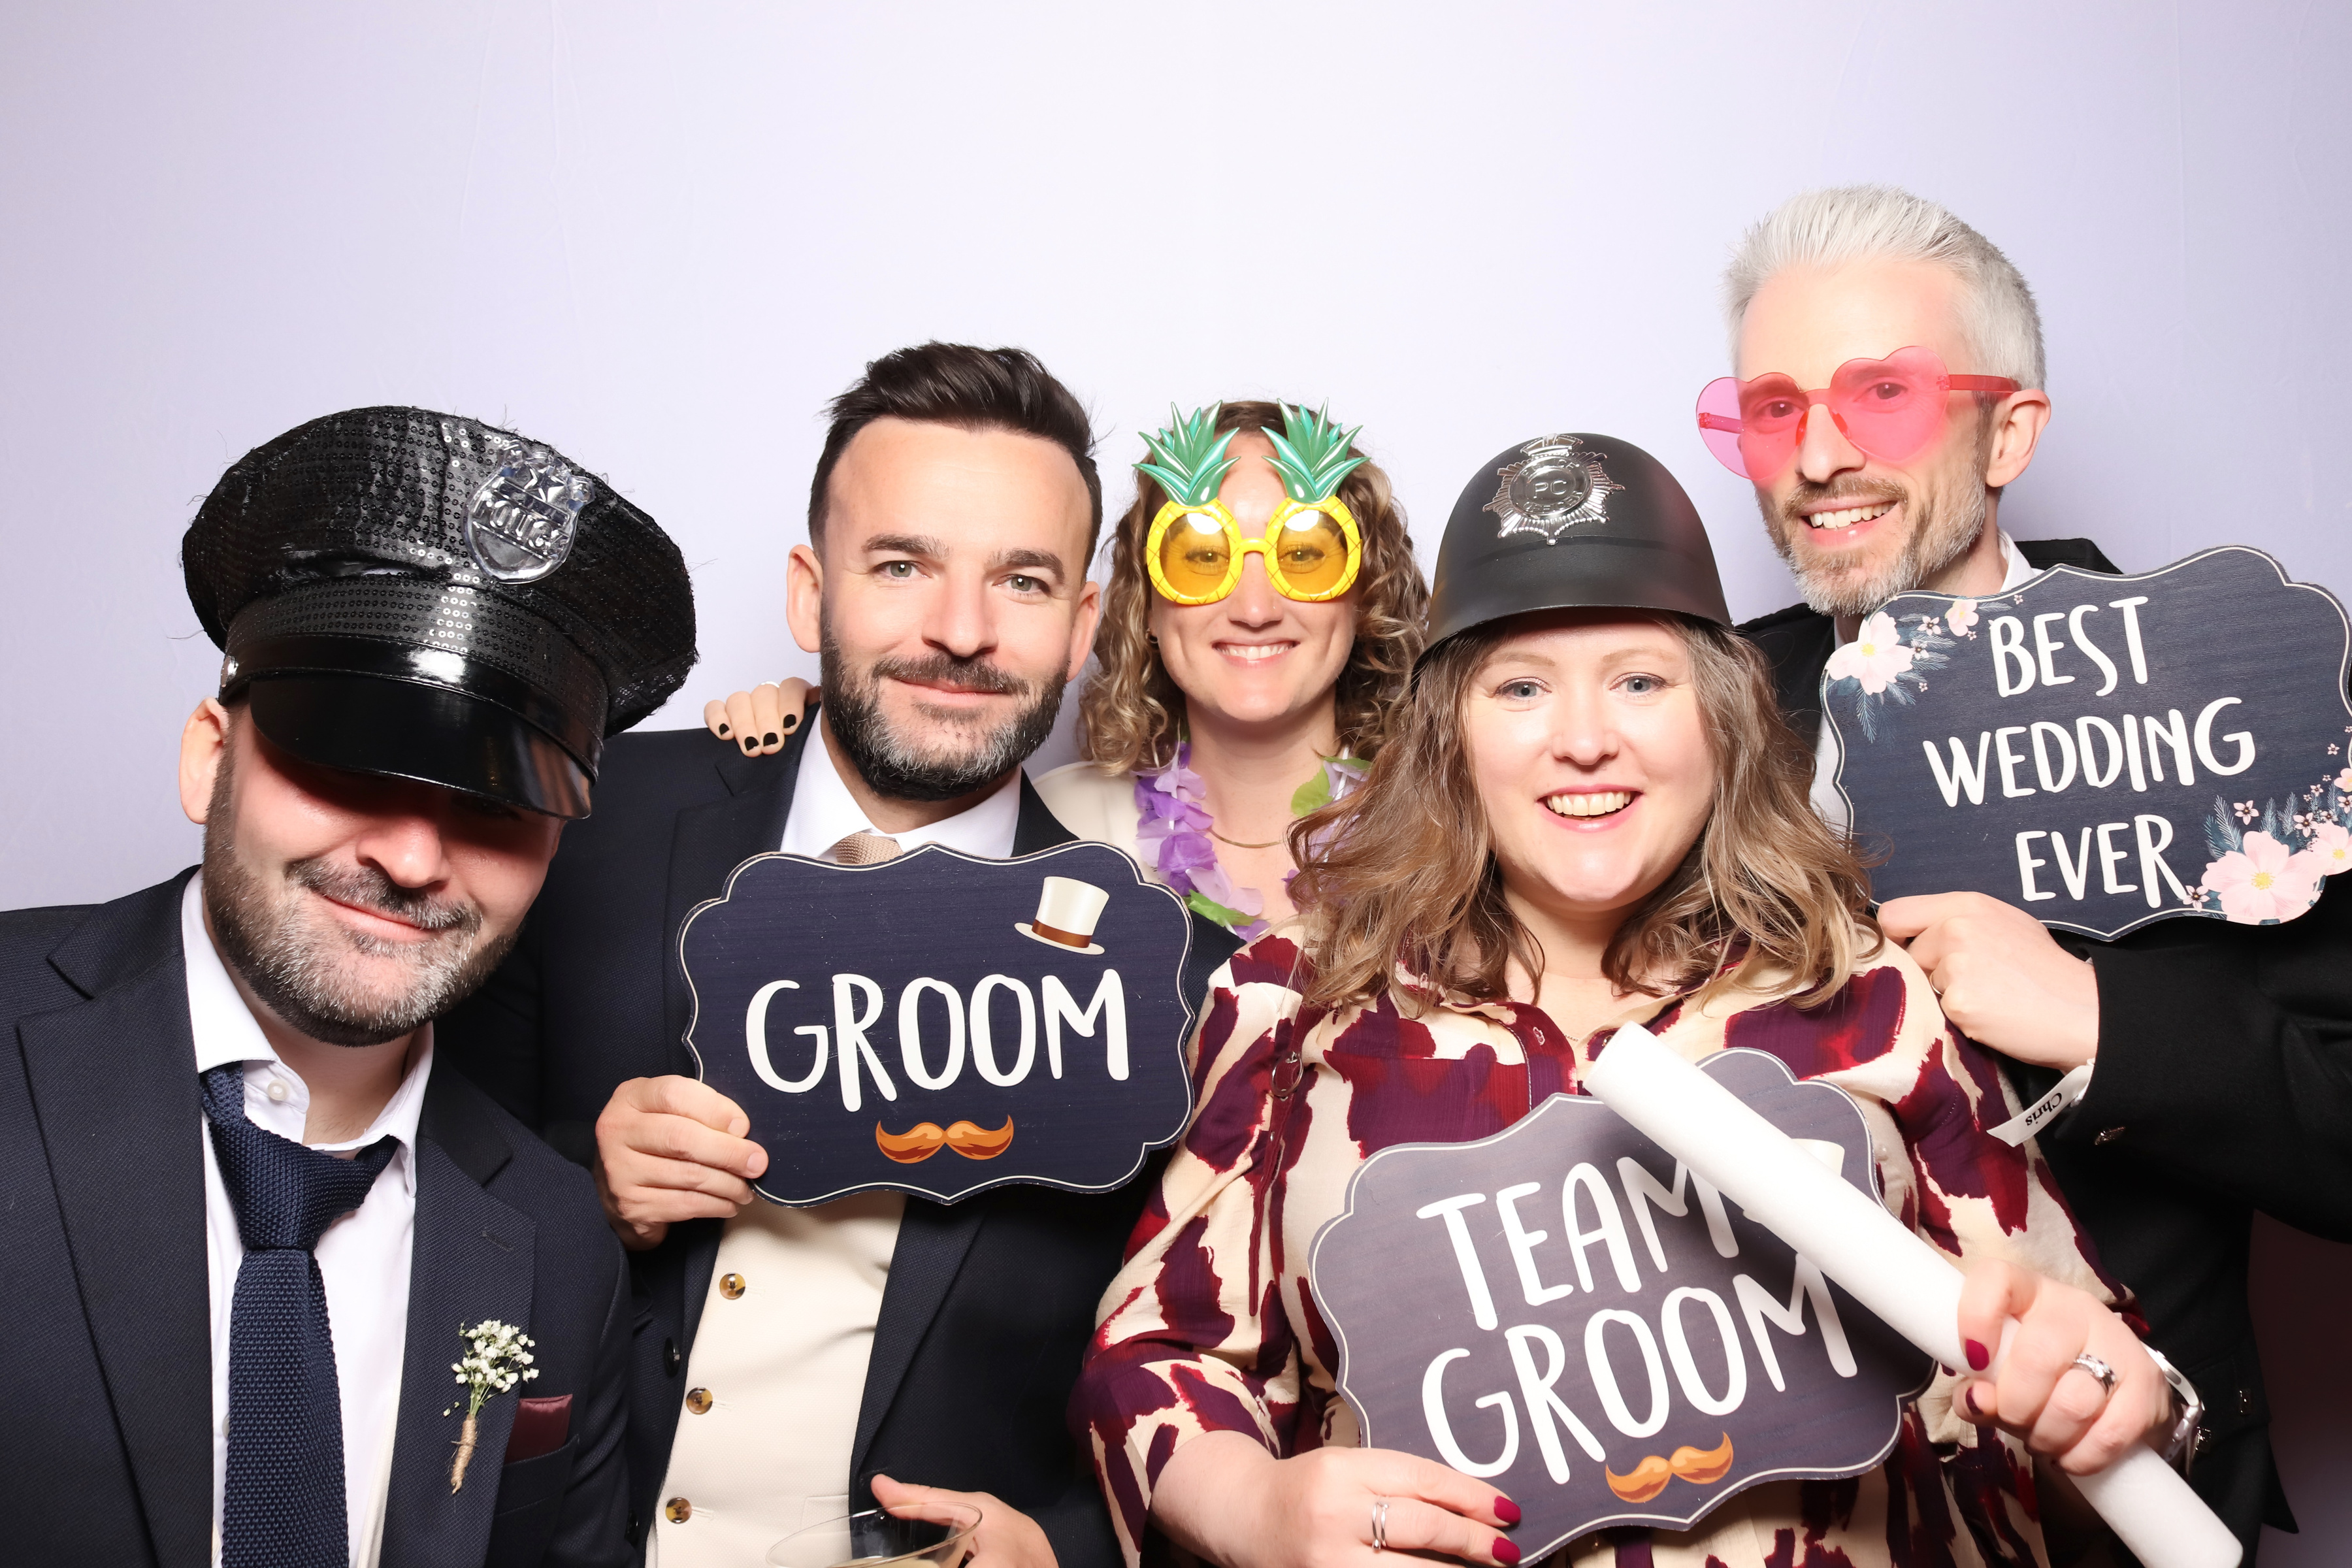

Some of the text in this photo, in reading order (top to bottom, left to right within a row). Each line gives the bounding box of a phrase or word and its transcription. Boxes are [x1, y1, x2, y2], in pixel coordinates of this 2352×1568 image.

[1522, 490, 1583, 513] OFFICER
[1533, 480, 1567, 498] PC
[1995, 596, 2148, 698] BEST
[1922, 696, 2255, 808] WEDDING
[2016, 814, 2187, 908] EVER
[745, 969, 1130, 1112] GROOM
[2025, 1092, 2062, 1126] Chris
[1416, 1155, 1740, 1331] TEAM
[1421, 1252, 1858, 1484] GROOM
